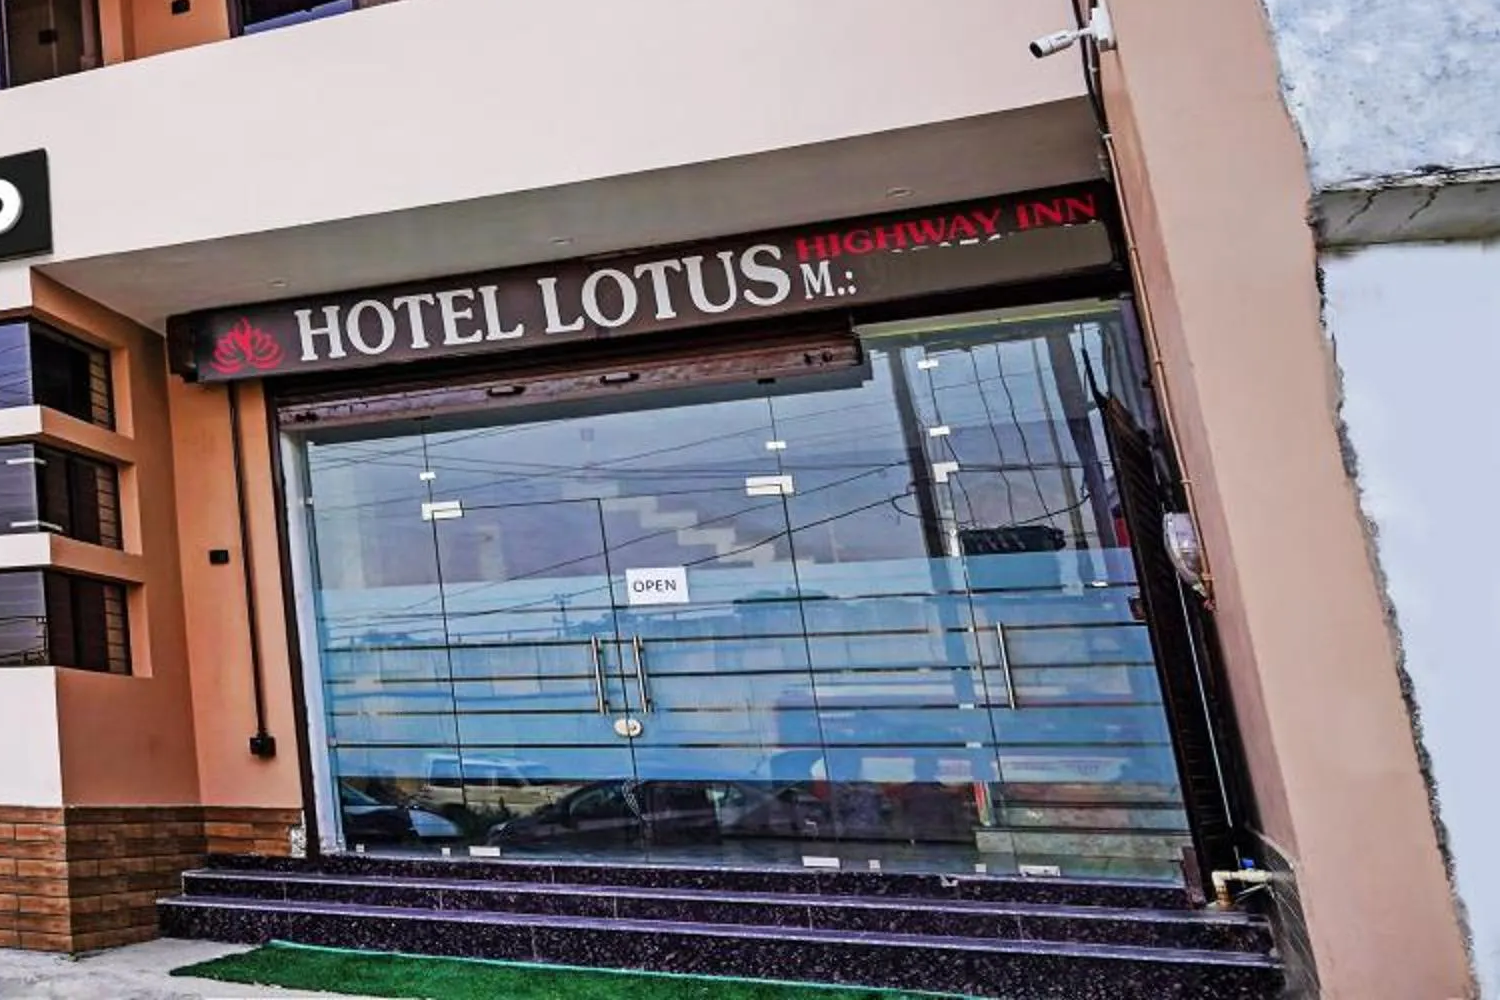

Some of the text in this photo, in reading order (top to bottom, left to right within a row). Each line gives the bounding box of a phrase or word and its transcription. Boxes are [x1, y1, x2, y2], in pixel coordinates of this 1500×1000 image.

[795, 208, 1001, 260] HIGHWAY
[1015, 194, 1097, 230] INN
[294, 244, 791, 361] HOTEL LOTUS
[633, 579, 677, 593] OPEN
